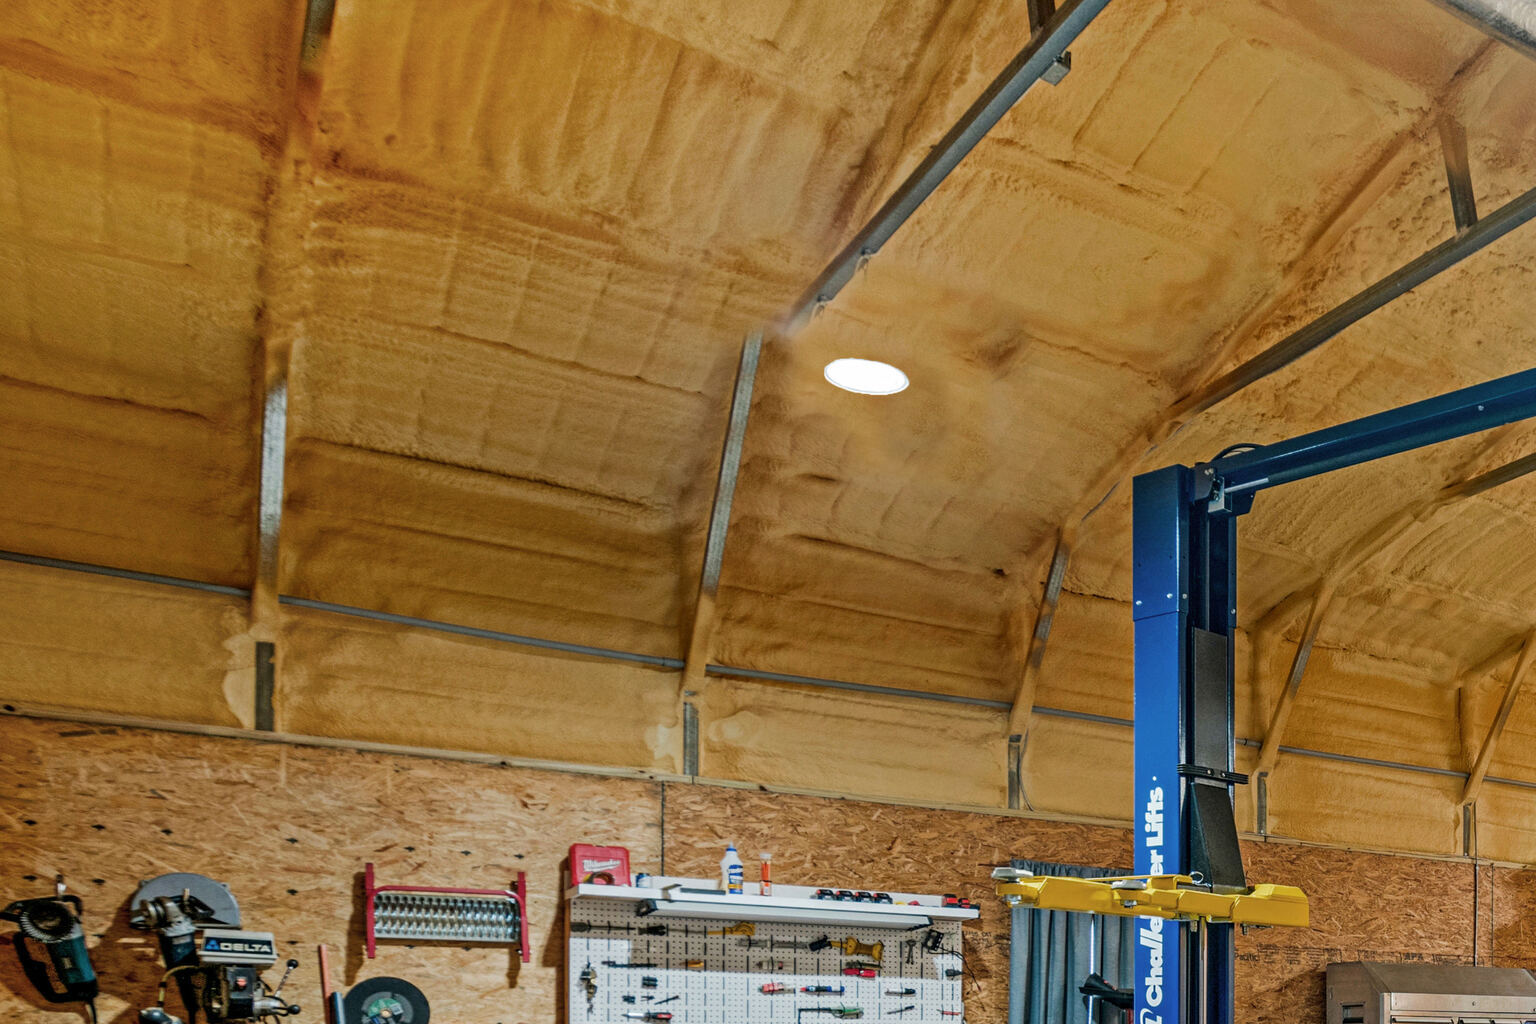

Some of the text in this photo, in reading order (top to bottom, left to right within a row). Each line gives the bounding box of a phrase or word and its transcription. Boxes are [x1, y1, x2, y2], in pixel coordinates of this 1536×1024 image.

[1145, 786, 1164, 847] Lifts
[219, 942, 271, 953] DELTA
[1140, 850, 1164, 1007] Challeer
